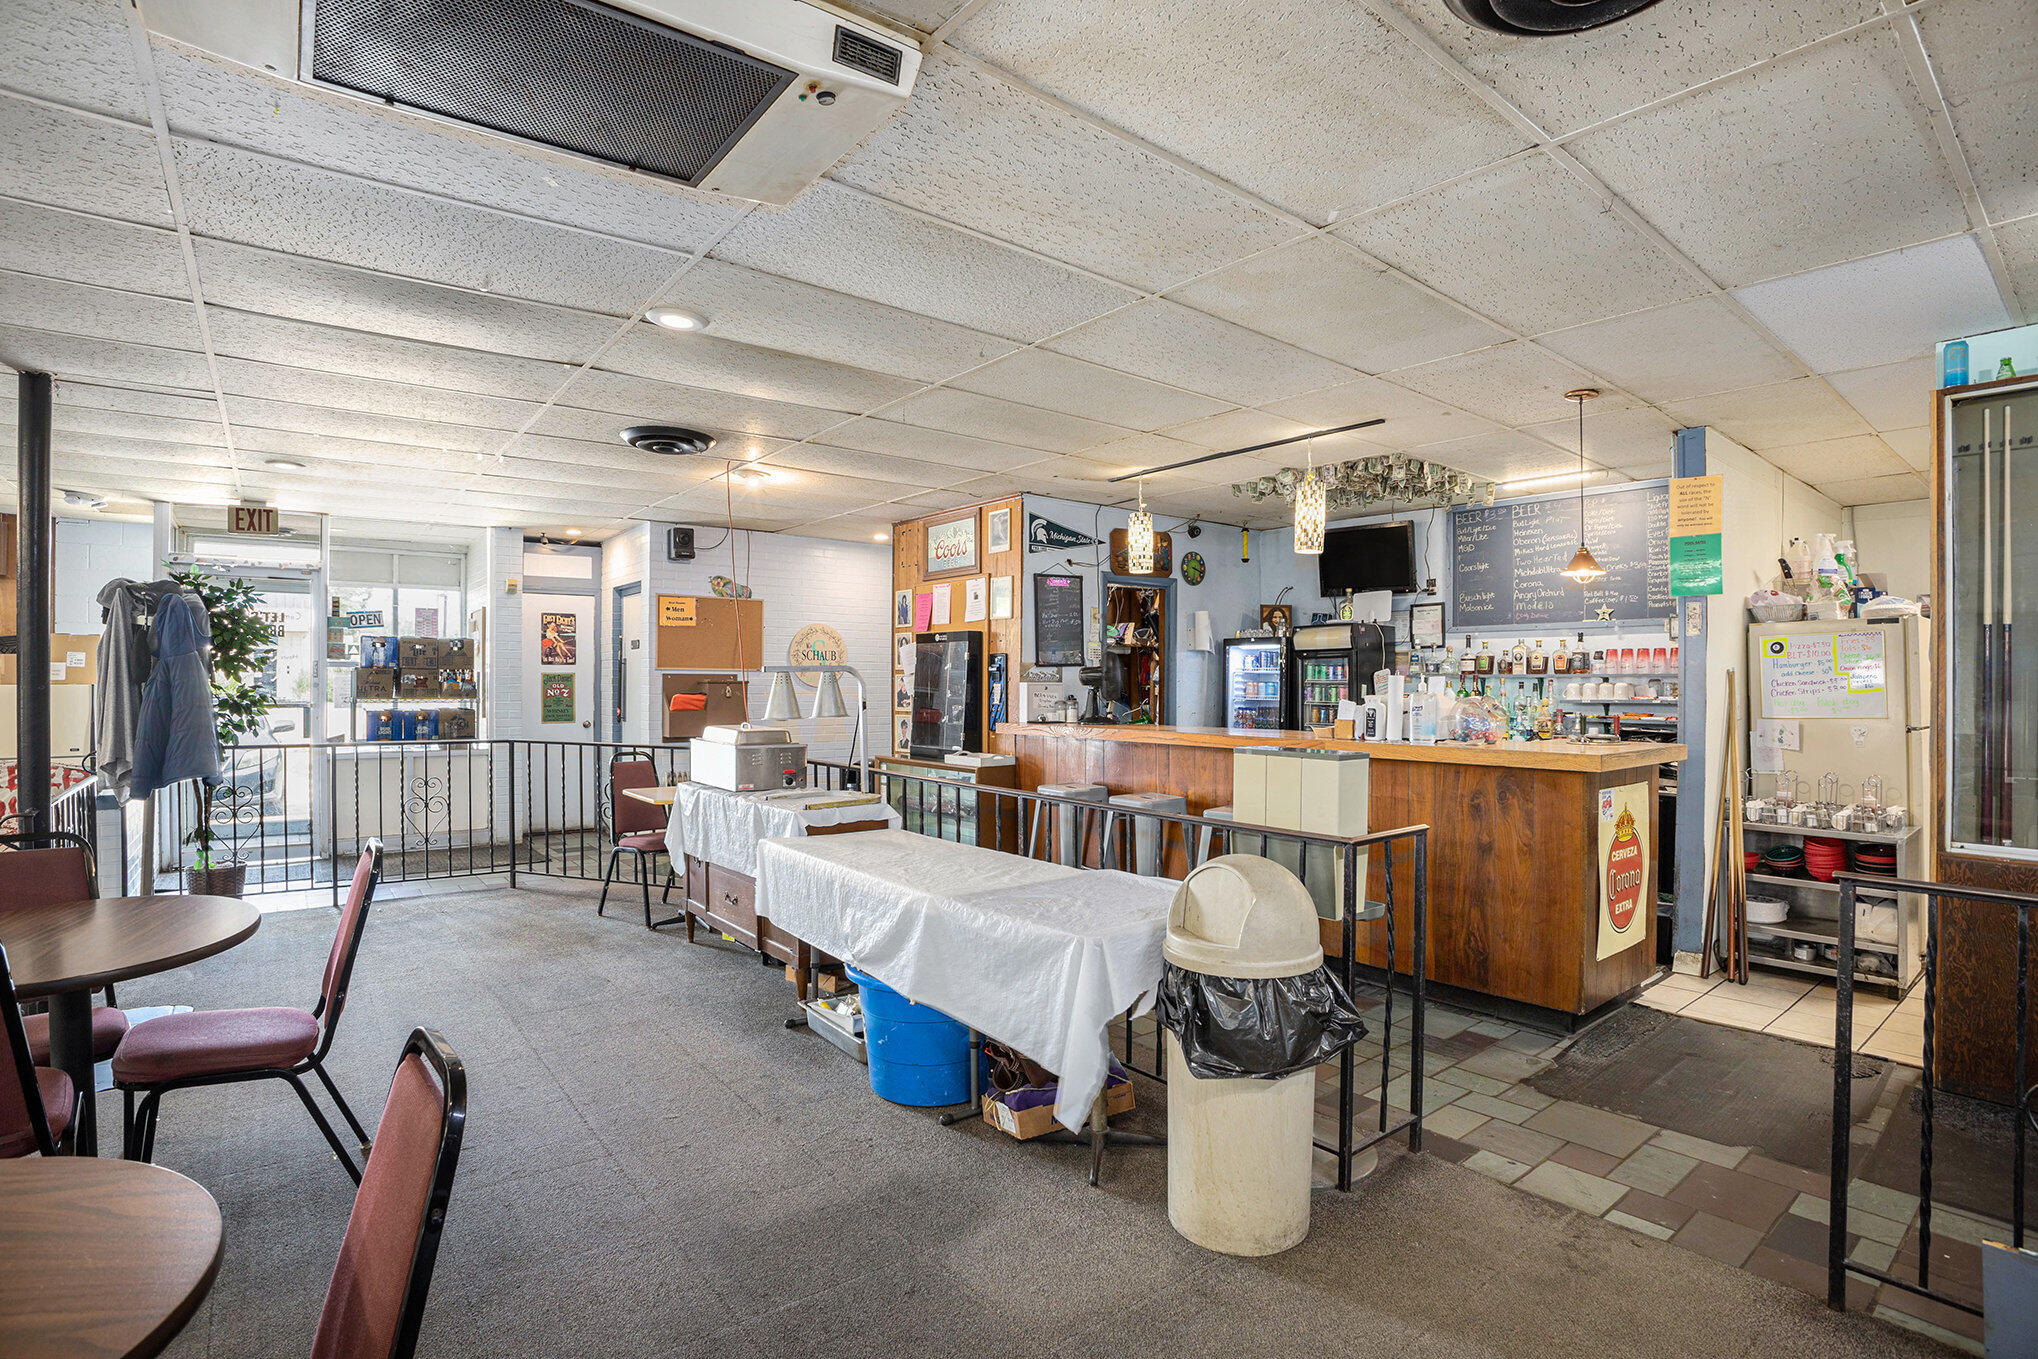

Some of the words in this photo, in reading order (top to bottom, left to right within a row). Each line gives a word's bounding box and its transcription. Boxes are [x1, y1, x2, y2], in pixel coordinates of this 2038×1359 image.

[1456, 510, 1482, 525] BEER
[1512, 503, 1541, 519] BEER
[235, 507, 274, 532] EXIT
[1049, 530, 1076, 543] Michigan
[934, 538, 968, 560] Coors
[1513, 579, 1545, 590] Corona
[350, 613, 381, 627] OPEN
[801, 650, 837, 662] SCHAUB
[1772, 658, 1811, 670] Hamburger
[561, 688, 570, 697] 7
[1611, 845, 1638, 862] CERVEZA
[1609, 868, 1641, 901] Corona
[1615, 898, 1633, 915] EXTRA
